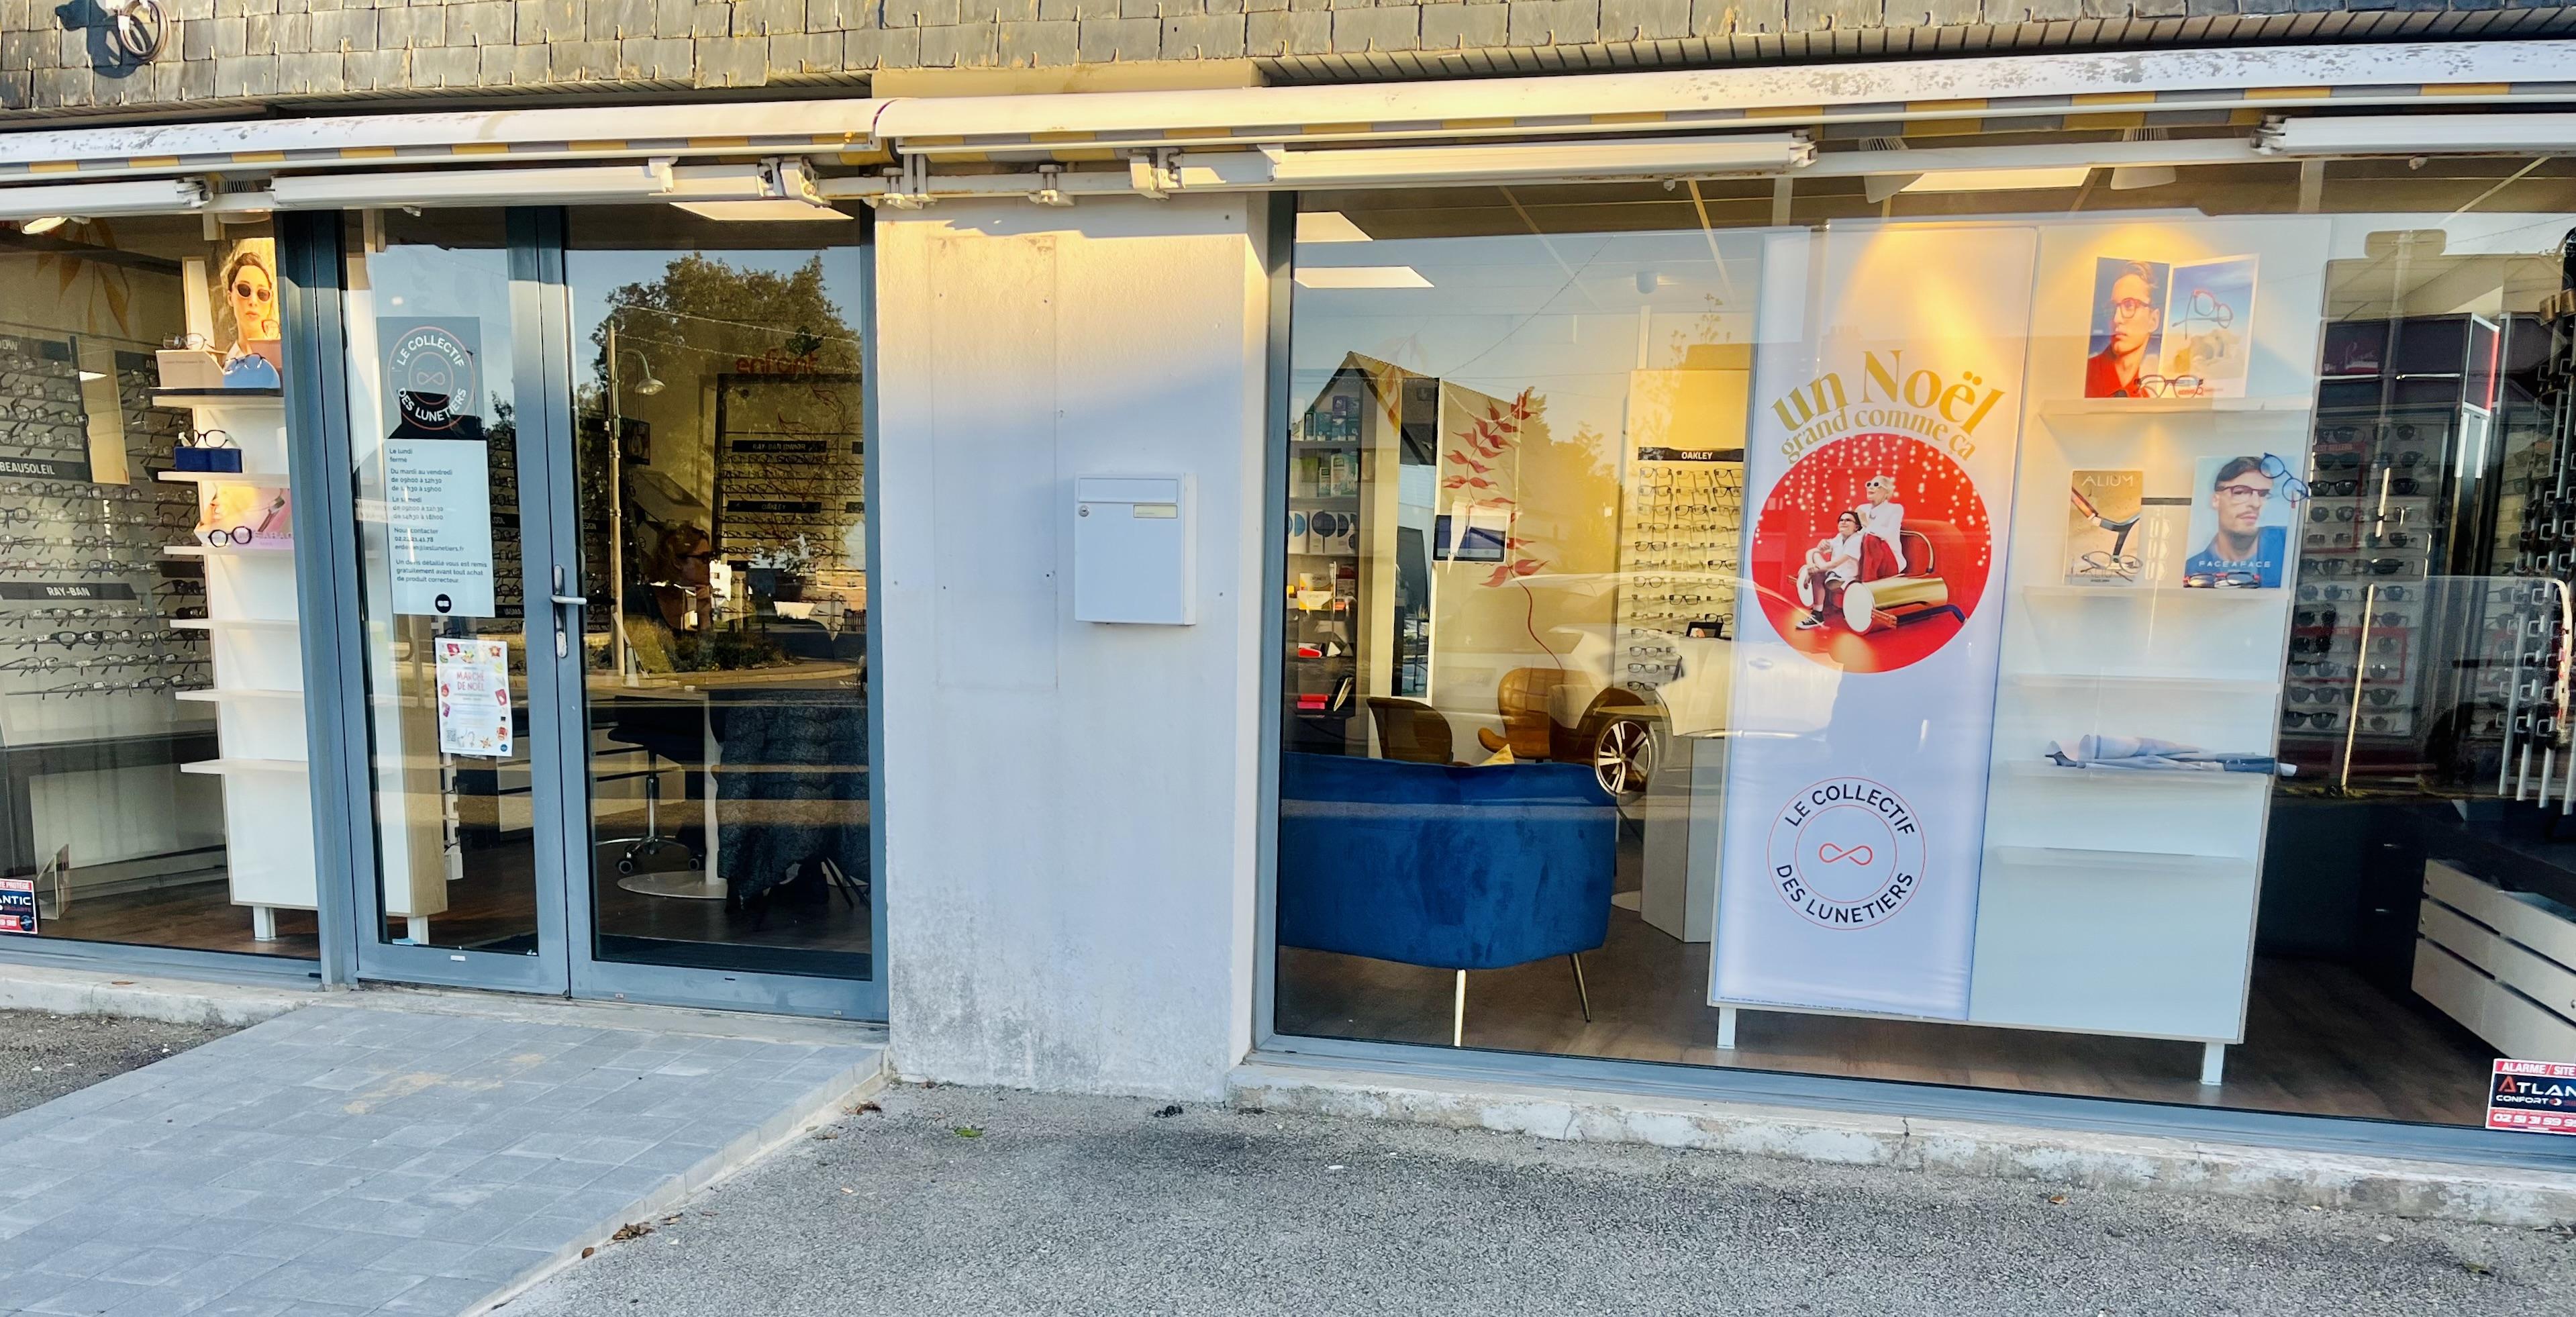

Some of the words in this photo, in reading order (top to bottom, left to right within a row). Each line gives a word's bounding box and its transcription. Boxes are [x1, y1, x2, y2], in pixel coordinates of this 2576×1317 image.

[397, 348, 411, 366] LE
[407, 335, 464, 367] COLLECTIF
[736, 348, 819, 373] enfant
[1769, 372, 1852, 432] un
[1862, 349, 2005, 437] Noël
[397, 387, 415, 411] DES
[415, 388, 466, 422] LUNETIERS
[1781, 408, 1849, 465] grand
[1854, 409, 1949, 442] comme
[1948, 434, 1977, 462] ça
[1681, 451, 1714, 460] OAKLEY
[0, 461, 56, 475] BEAUSOLEIL
[2081, 475, 2133, 487] ALIUM
[2198, 560, 2271, 568] FACEAFACE
[405, 575, 427, 583] produit
[46, 586, 91, 597] RAY-BAN
[457, 681, 466, 691] DE
[1784, 801, 1811, 827] LE
[1812, 783, 1915, 834] COLLECTIF
[1776, 864, 1805, 902] DES
[1805, 872, 1913, 923] LUNETIERS
[2501, 1062, 2546, 1074] ALARME
[2553, 1065, 2576, 1076] SITE
[2495, 1094, 2549, 1105] CONFORT
[2493, 1113, 2512, 1123] 02
